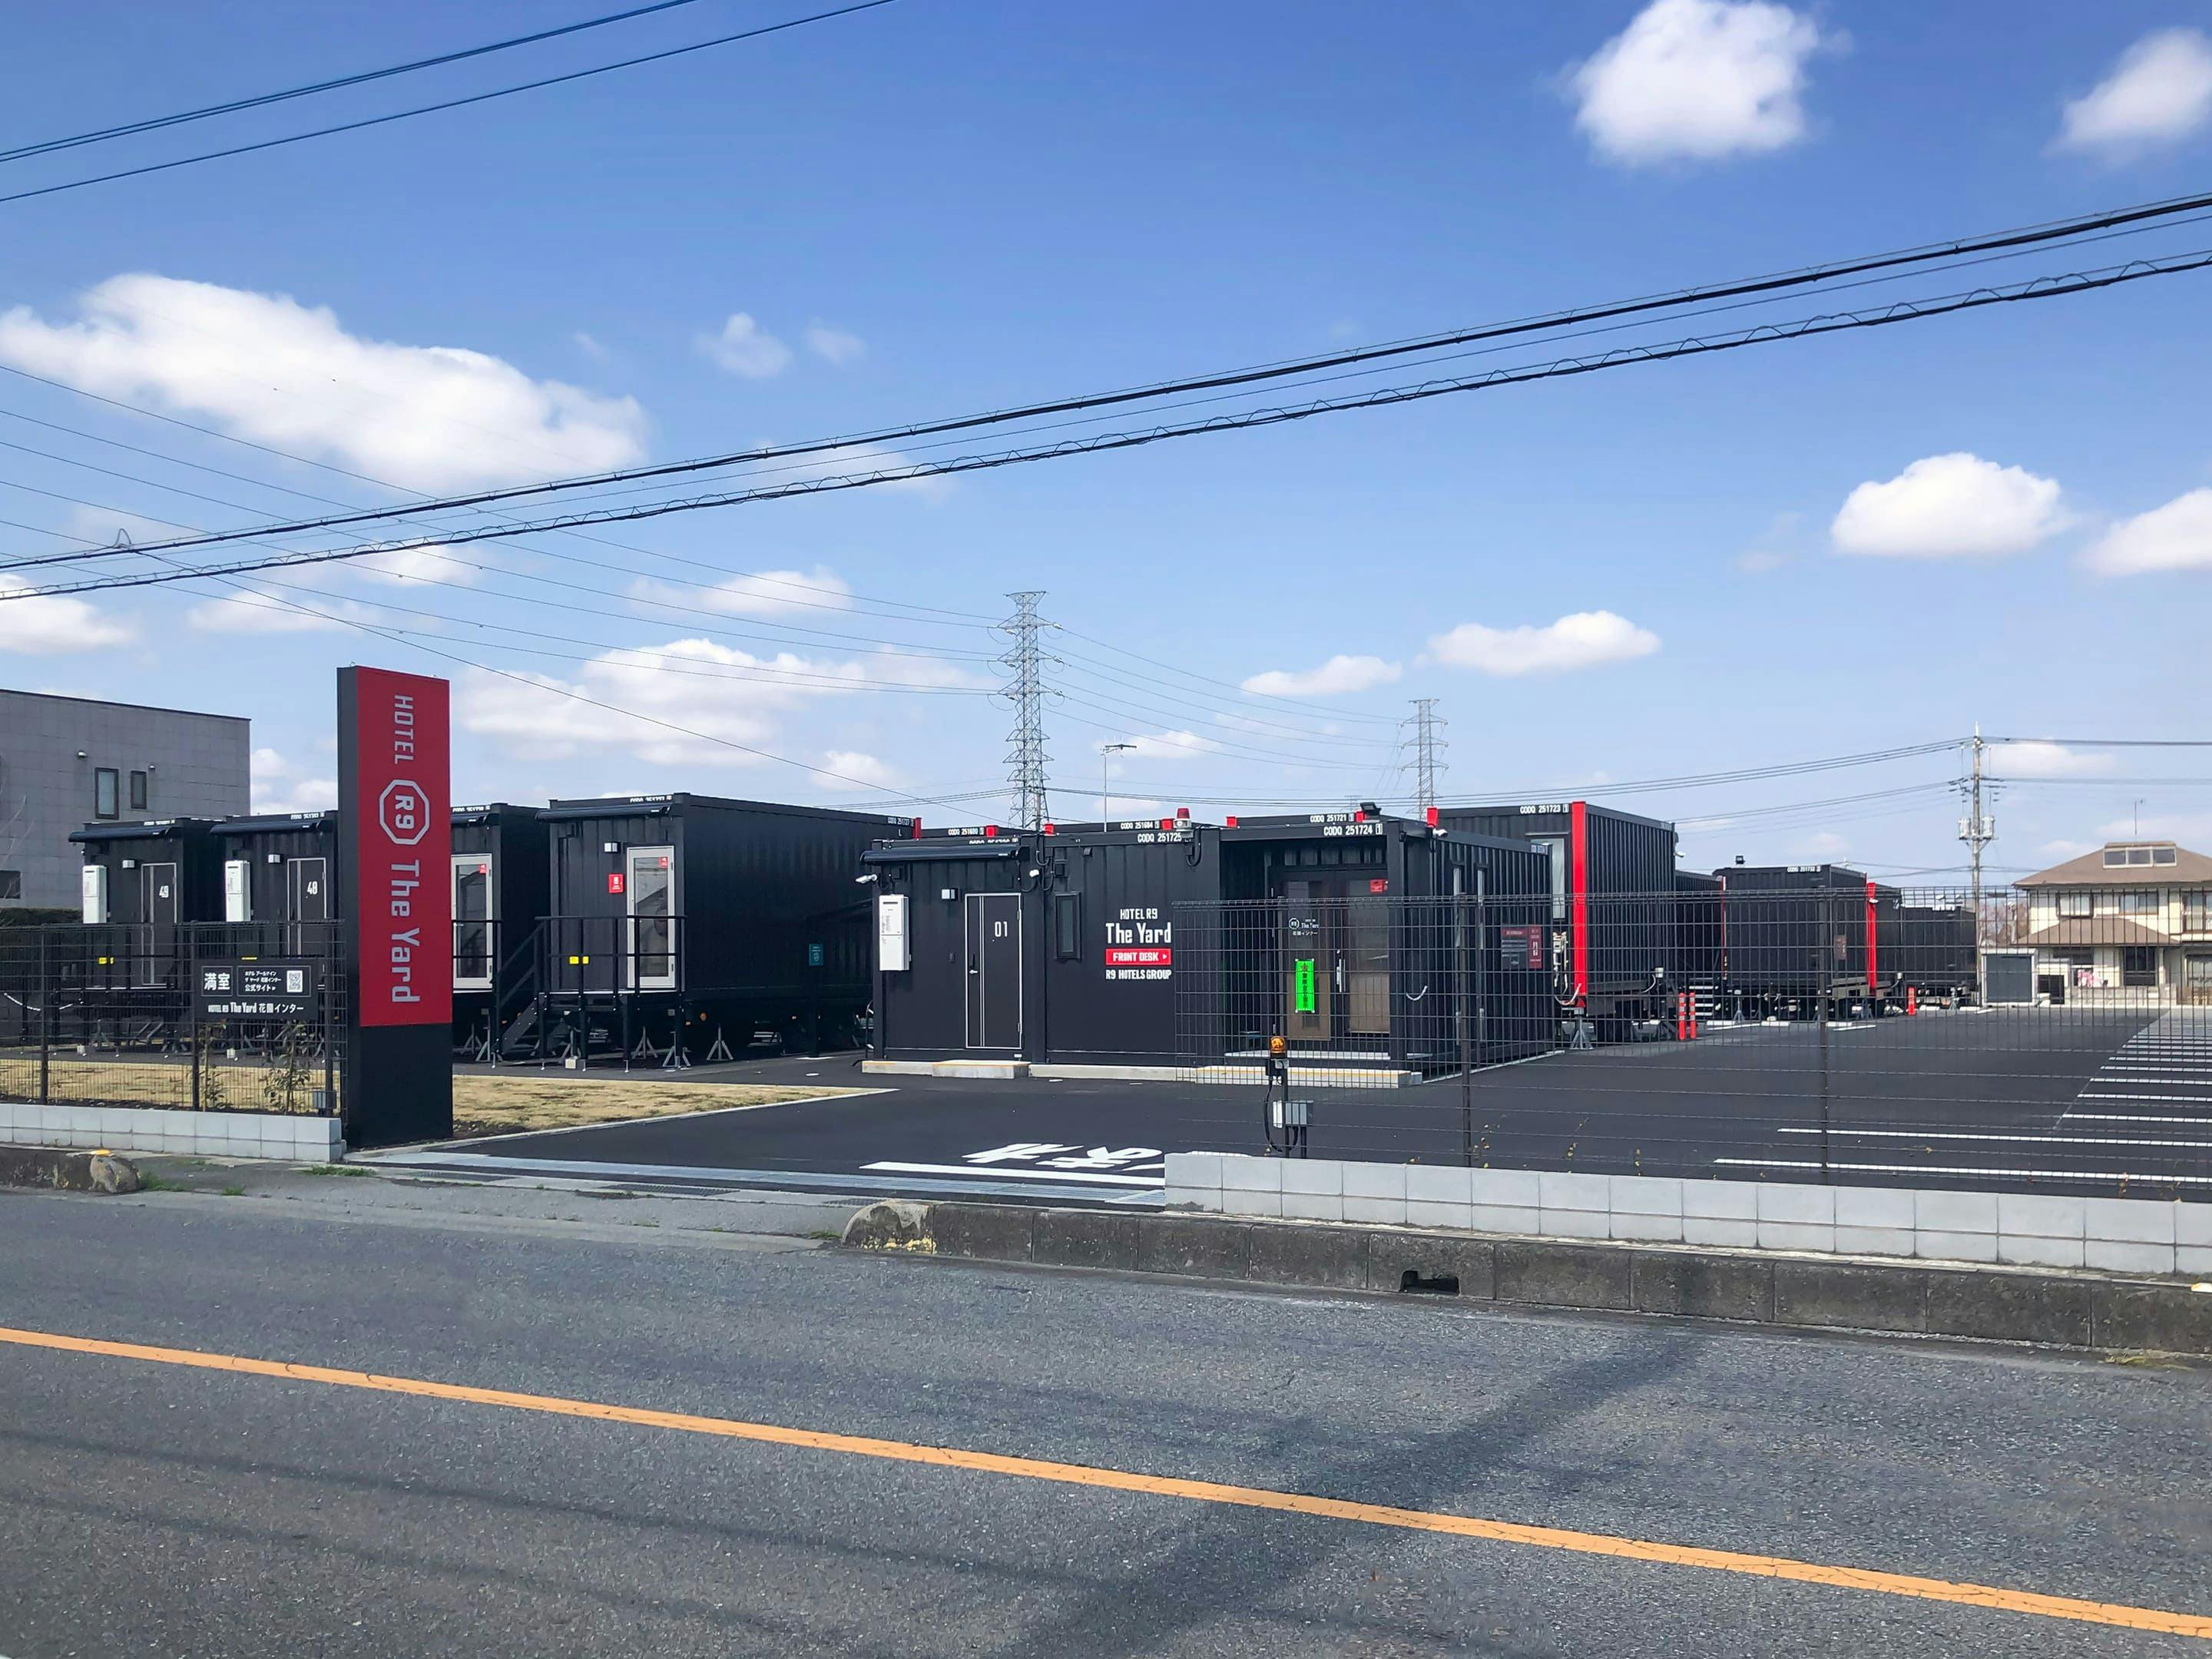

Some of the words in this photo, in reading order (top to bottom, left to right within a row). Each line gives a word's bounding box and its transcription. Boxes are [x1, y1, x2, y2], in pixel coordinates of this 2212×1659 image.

[394, 694, 414, 764] HOTEL
[395, 794, 415, 830] R9
[1538, 804, 1561, 813] 251723
[1326, 813, 1346, 822] 251721
[1345, 825, 1373, 836] 251724
[1157, 832, 1182, 843] 251725
[159, 885, 169, 898] 49
[307, 881, 318, 895] 48
[391, 859, 420, 916] The
[1120, 909, 1145, 920] HOTEL
[1146, 908, 1157, 920] R9
[995, 921, 1008, 937] 01
[1106, 922, 1133, 944] The
[1136, 922, 1171, 943] Yard
[1113, 952, 1137, 962] FRONT
[1139, 952, 1159, 962] DESK
[391, 926, 420, 1002] Yard
[1106, 969, 1116, 979] R9
[1118, 969, 1145, 979] HOTELS
[1146, 969, 1171, 979] GROUP
[204, 972, 230, 991] 満室
[230, 1002, 241, 1013] The
[241, 1002, 257, 1013] Yard
